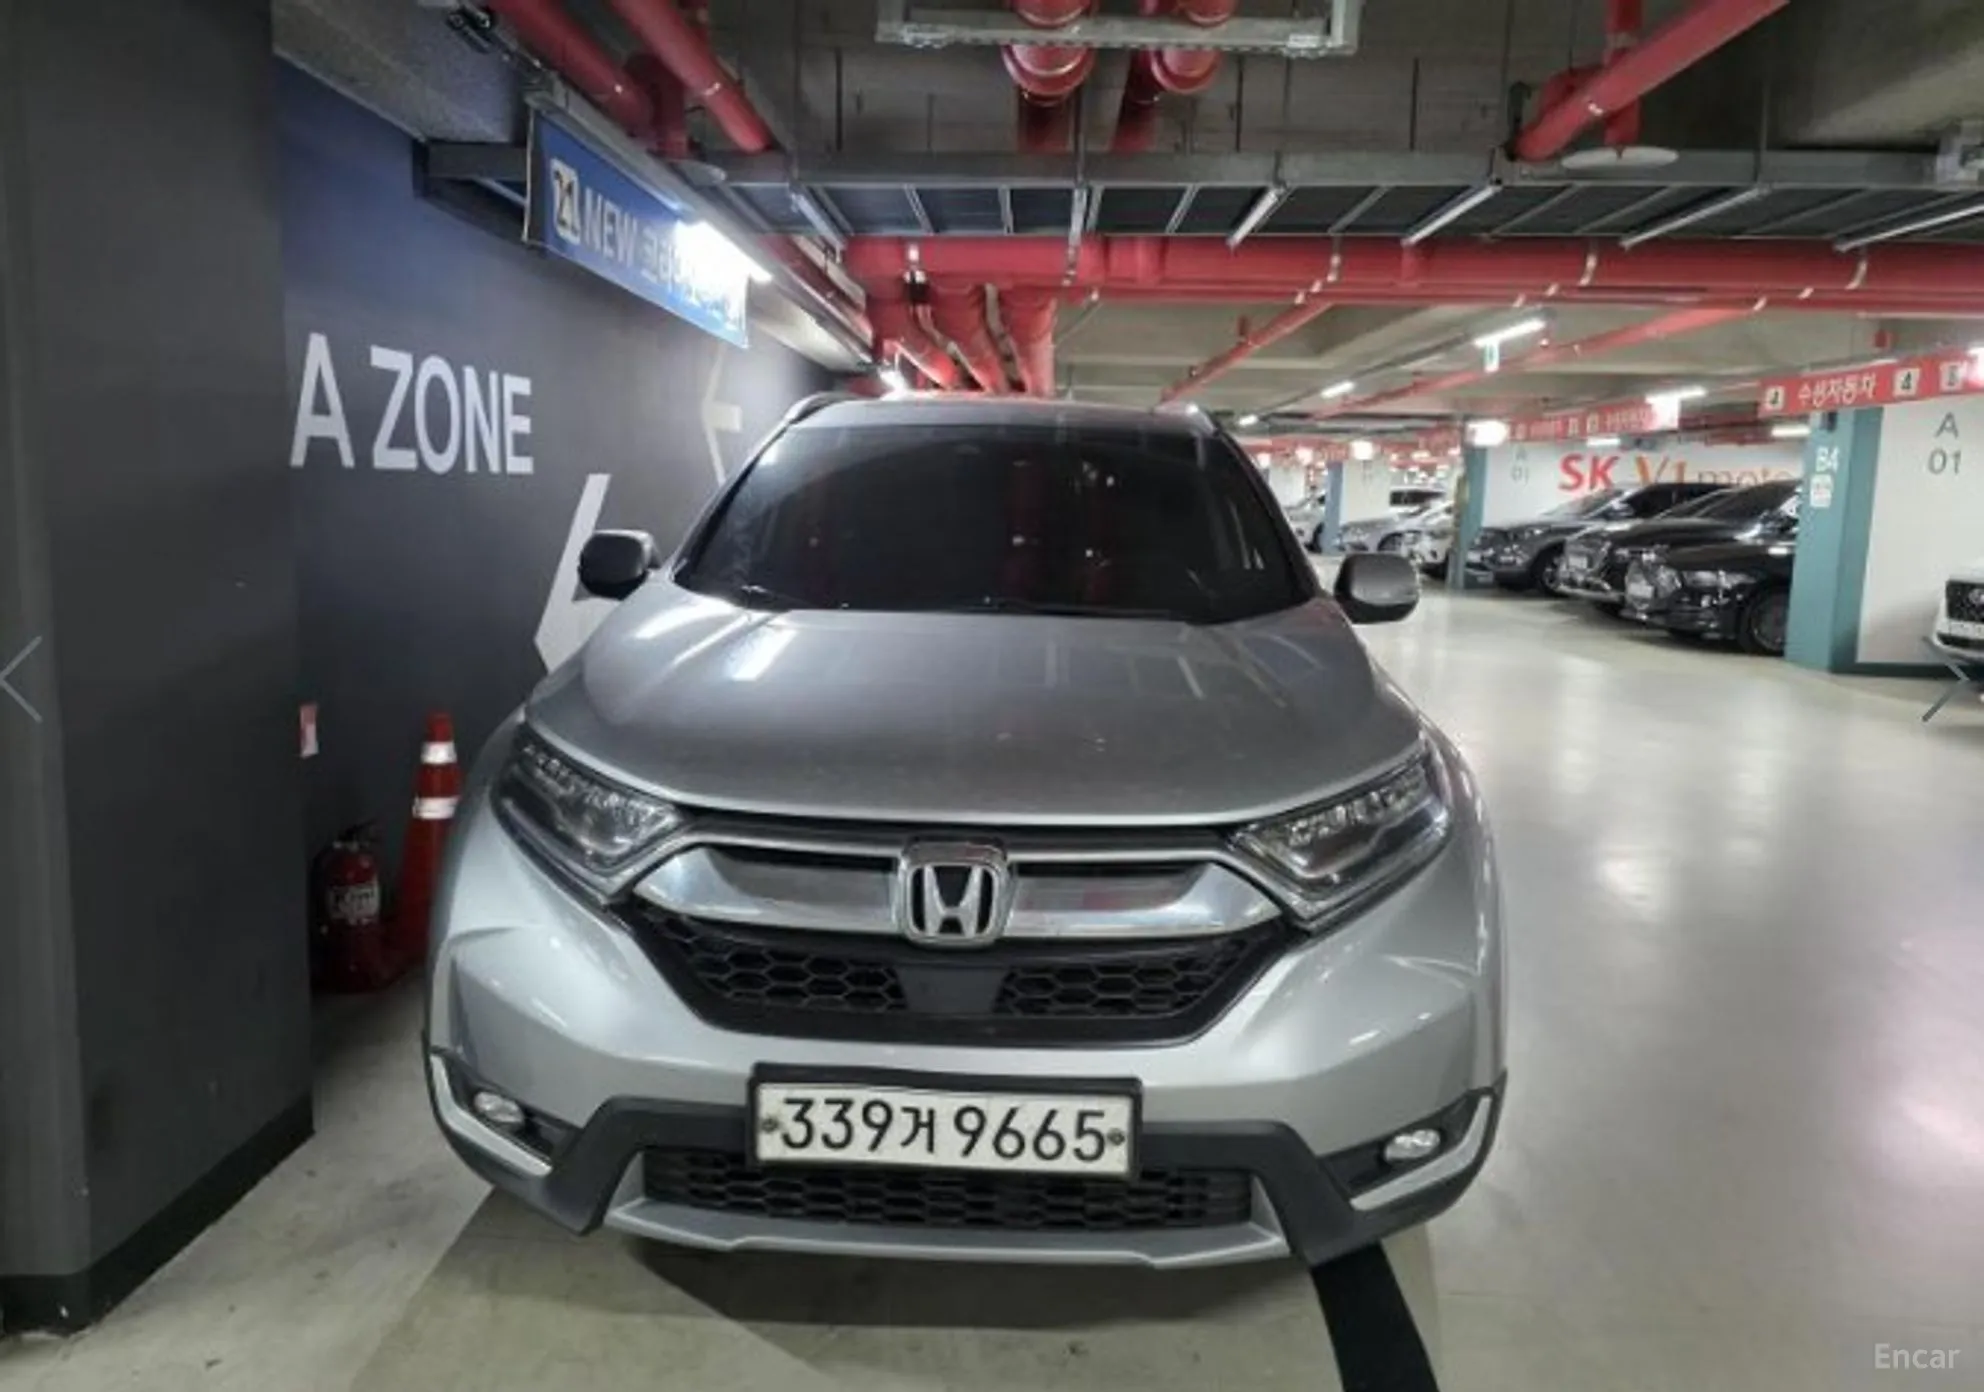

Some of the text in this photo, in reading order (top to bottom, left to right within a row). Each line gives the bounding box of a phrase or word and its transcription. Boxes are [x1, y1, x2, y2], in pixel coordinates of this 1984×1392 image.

[585, 187, 638, 268] NEW
[290, 332, 534, 474] A ZONE
[1934, 412, 1959, 438] A
[1558, 453, 1618, 491] SK
[1928, 448, 1962, 475] 01
[782, 1098, 1106, 1162] 339거 9665
